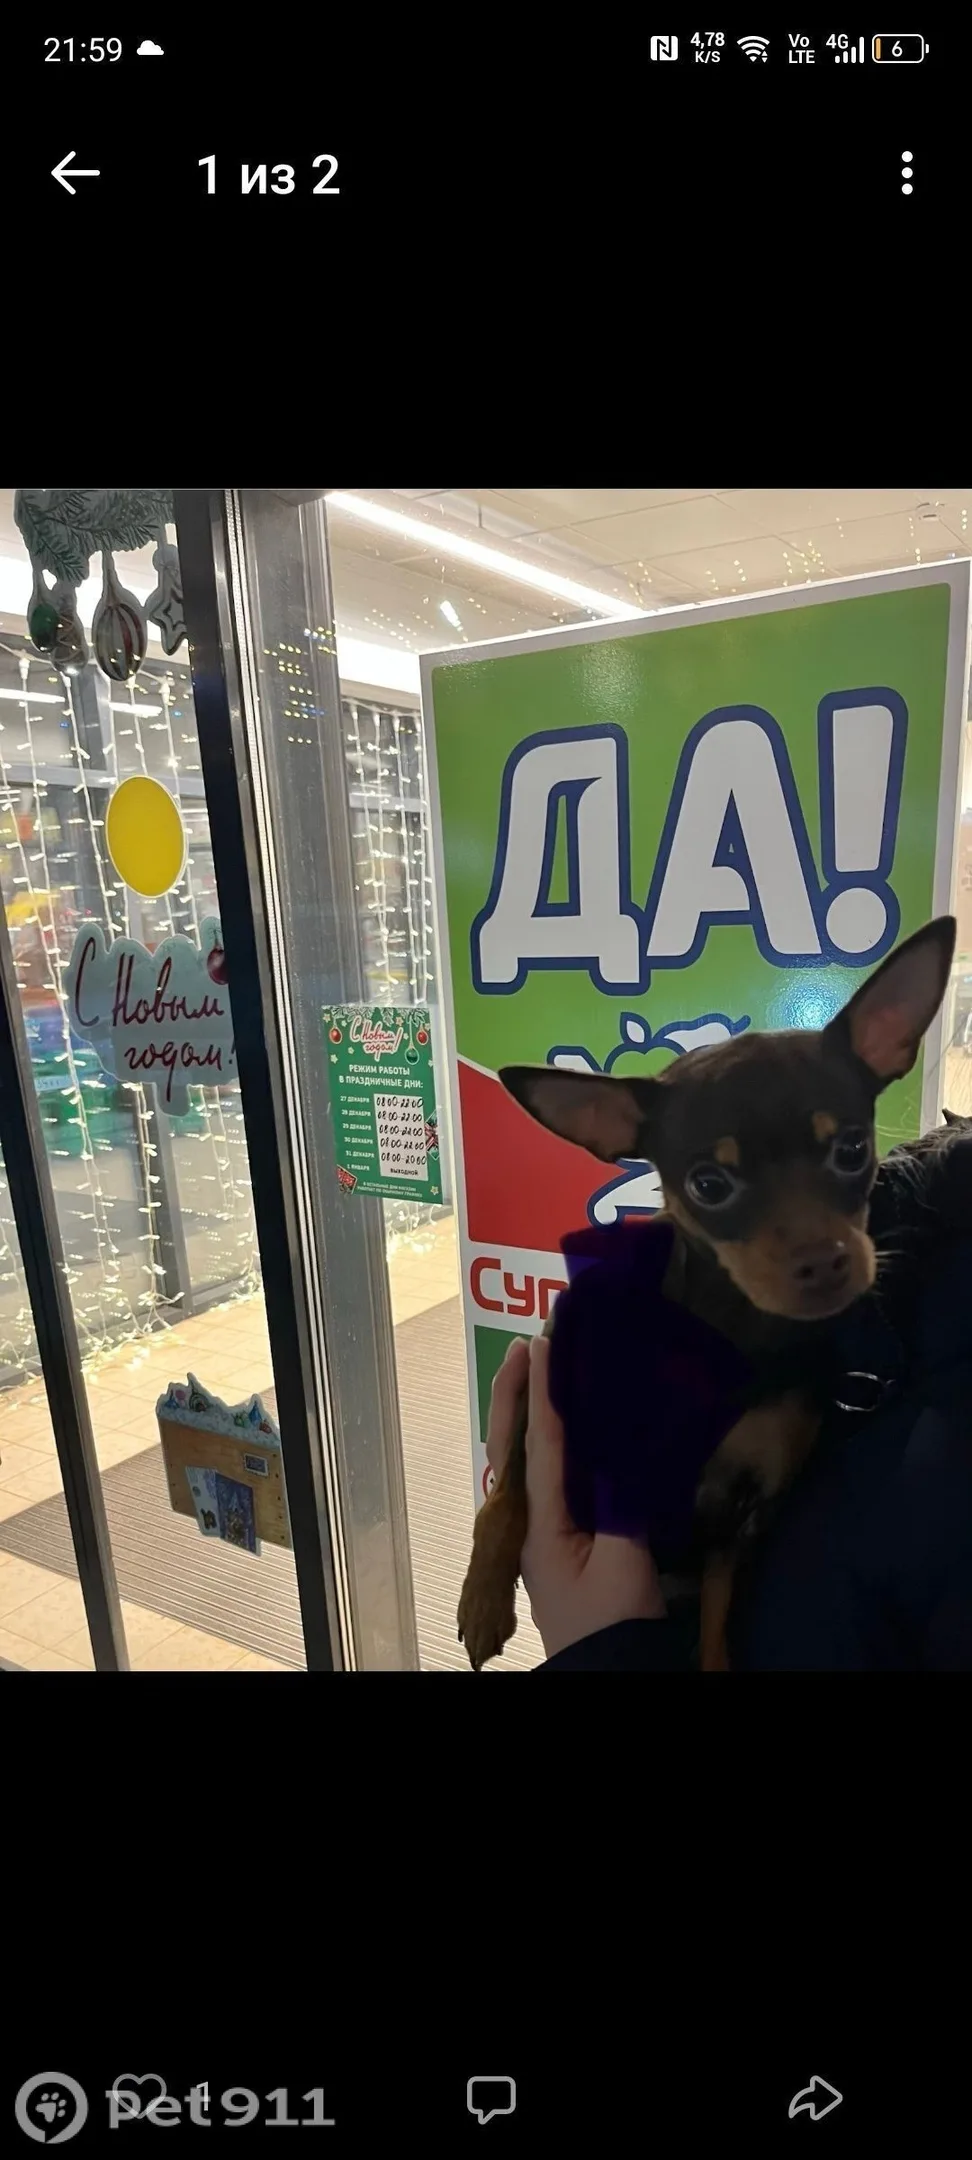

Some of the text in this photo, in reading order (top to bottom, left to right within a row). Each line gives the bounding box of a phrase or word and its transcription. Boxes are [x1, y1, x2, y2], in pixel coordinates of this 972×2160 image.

[471, 687, 908, 995] ДА!
[75, 937, 224, 1027] С Новым
[362, 1020, 395, 1041] Новым
[349, 1064, 410, 1075] РЕЖИМ РАБОТЫ
[339, 1075, 423, 1089] В ПРАЗДНИЧНЫЕ ДНИ:
